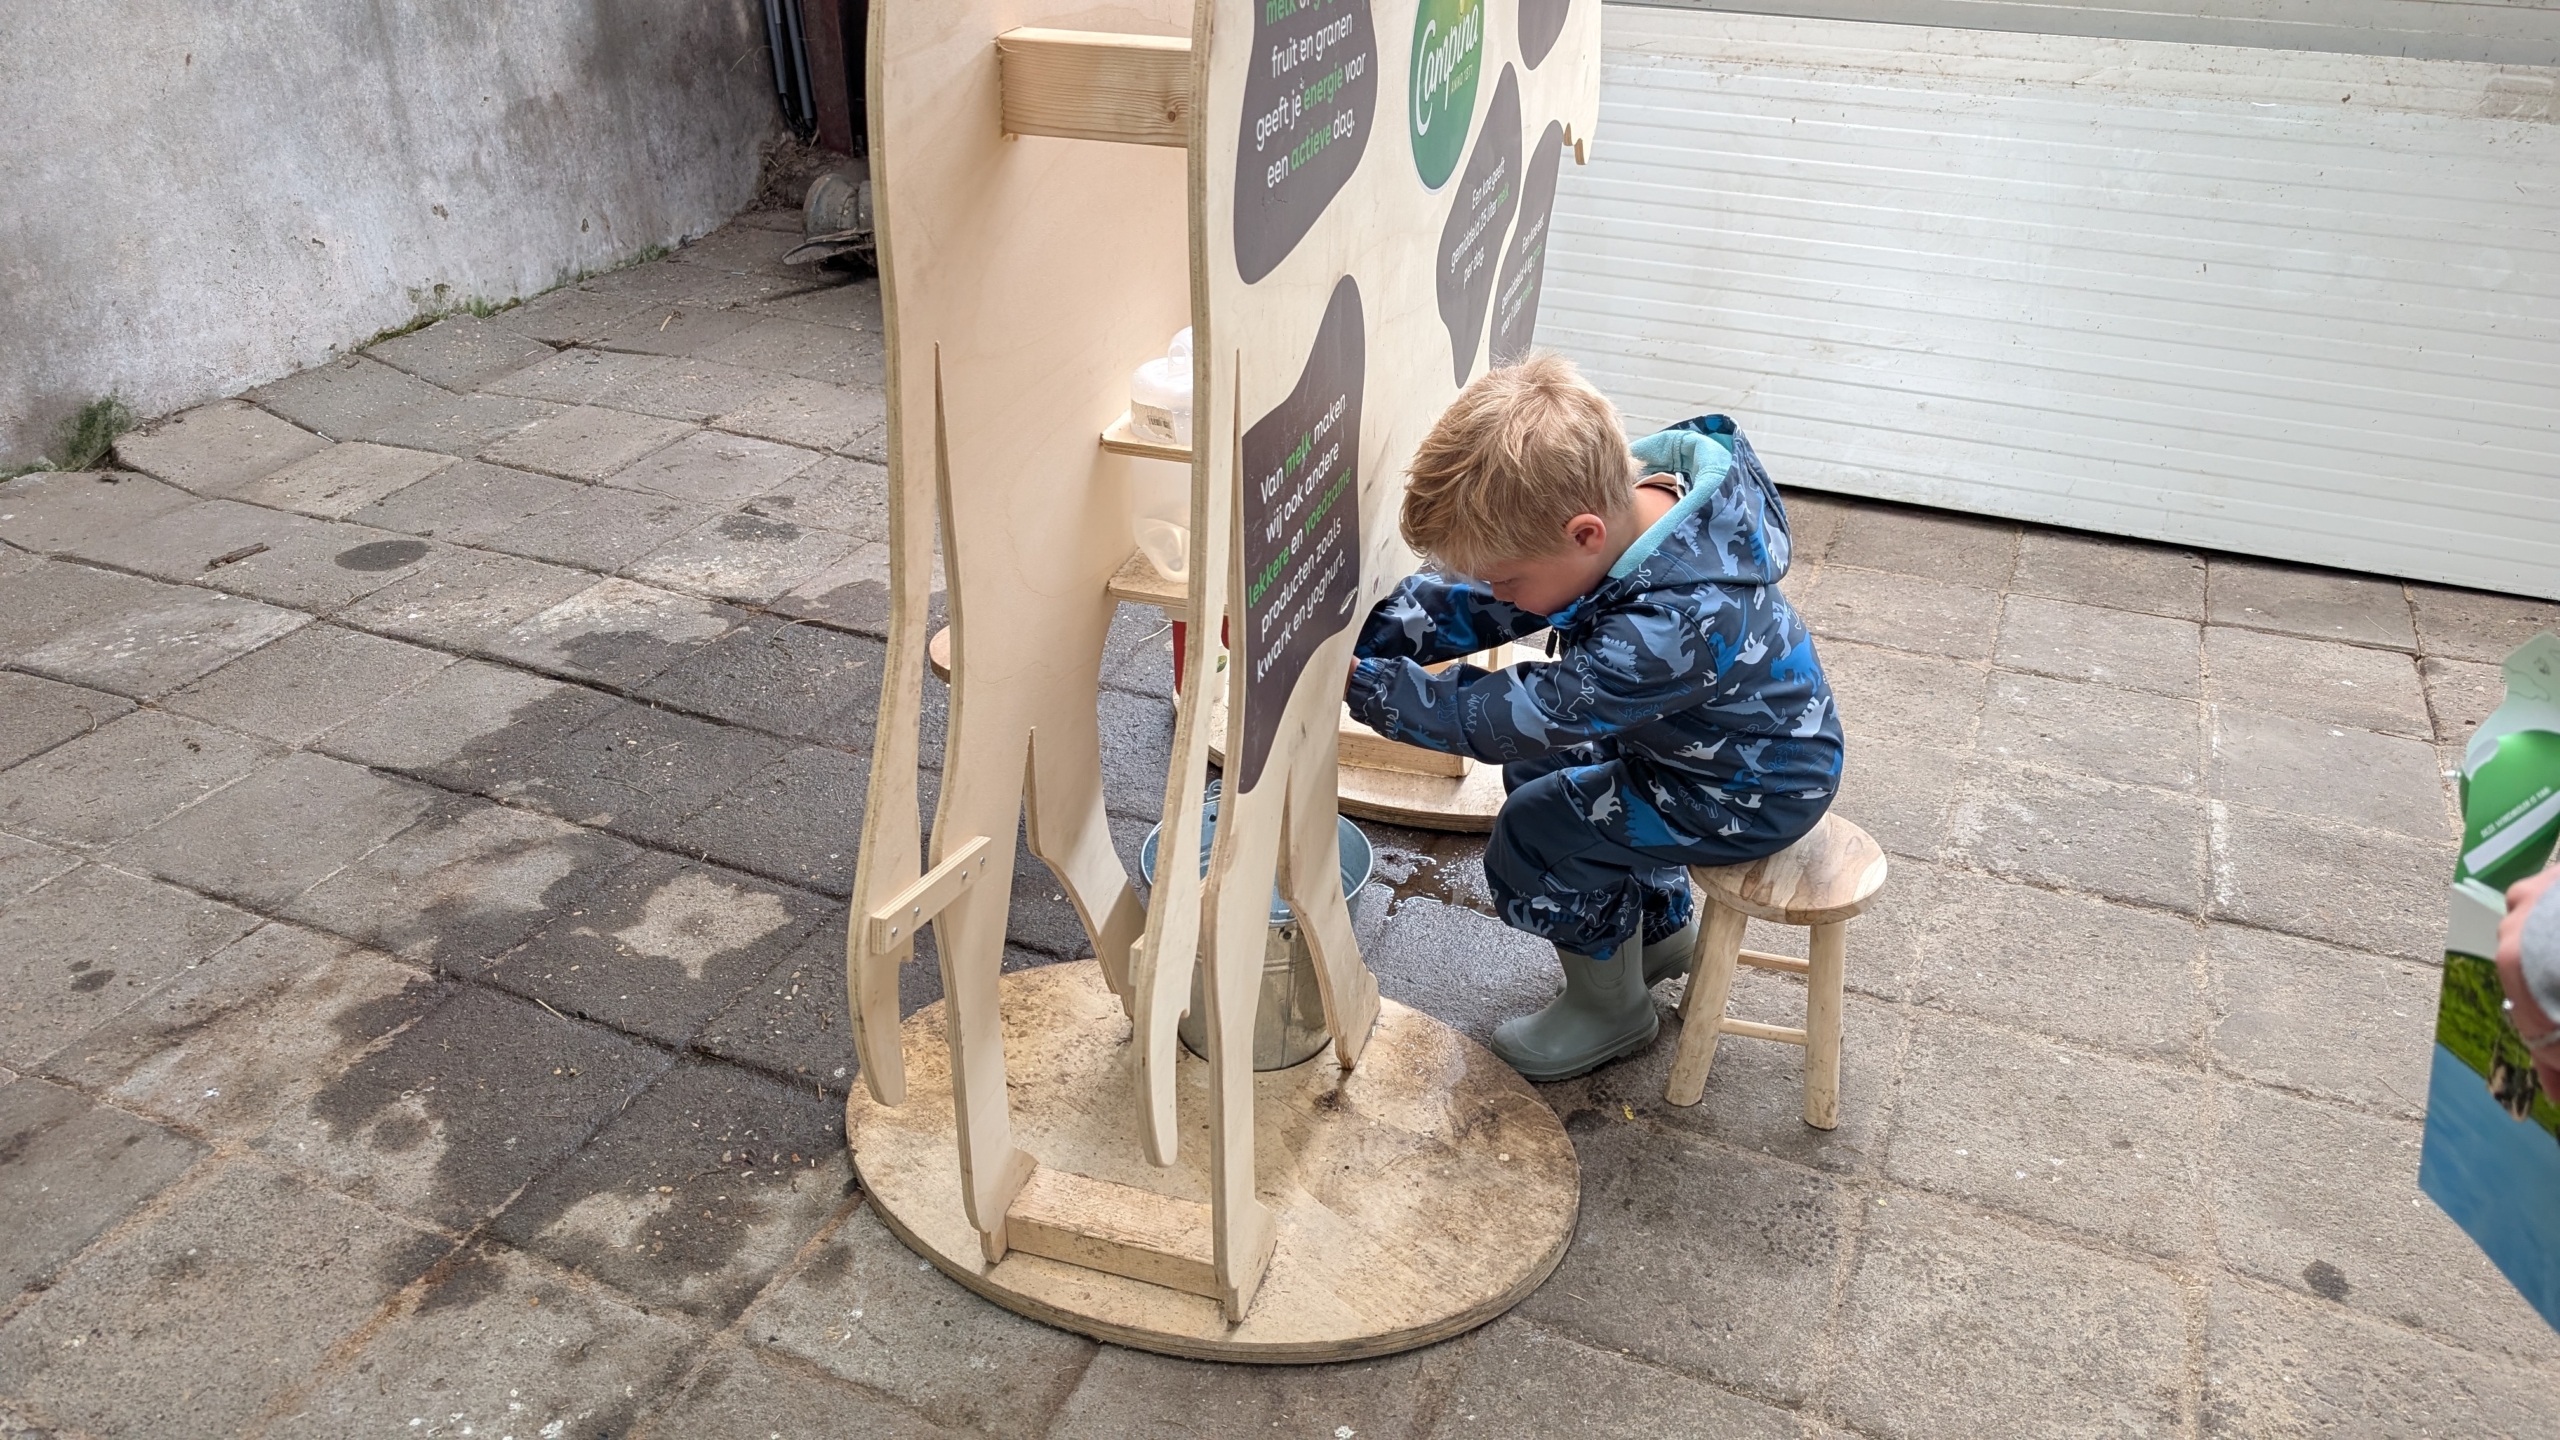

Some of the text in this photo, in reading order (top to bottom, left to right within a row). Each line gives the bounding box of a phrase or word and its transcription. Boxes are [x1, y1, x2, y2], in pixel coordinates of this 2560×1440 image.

[1271, 13, 1352, 78] fruit en granen
[1416, 4, 1479, 136] Campina
[1256, 52, 1366, 151] geeft je energie voor
[1267, 108, 1355, 188] een actieve dag.
[1450, 183, 1509, 274] gemiddeld 25 liter melk
[1472, 156, 1505, 211] Een koe geeft
[1463, 245, 1485, 289] per dag.
[1522, 236, 1530, 255] Een
[1530, 226, 1538, 245] koe
[1501, 267, 1524, 315] gemiddeld
[1260, 394, 1346, 504] Van melk maken
[1266, 442, 1339, 543] wij ook andere
[1248, 467, 1351, 609] lekkere en voedzame
[1261, 516, 1342, 643] producten zoals
[1256, 549, 1346, 683] kwark en yoghurt.
